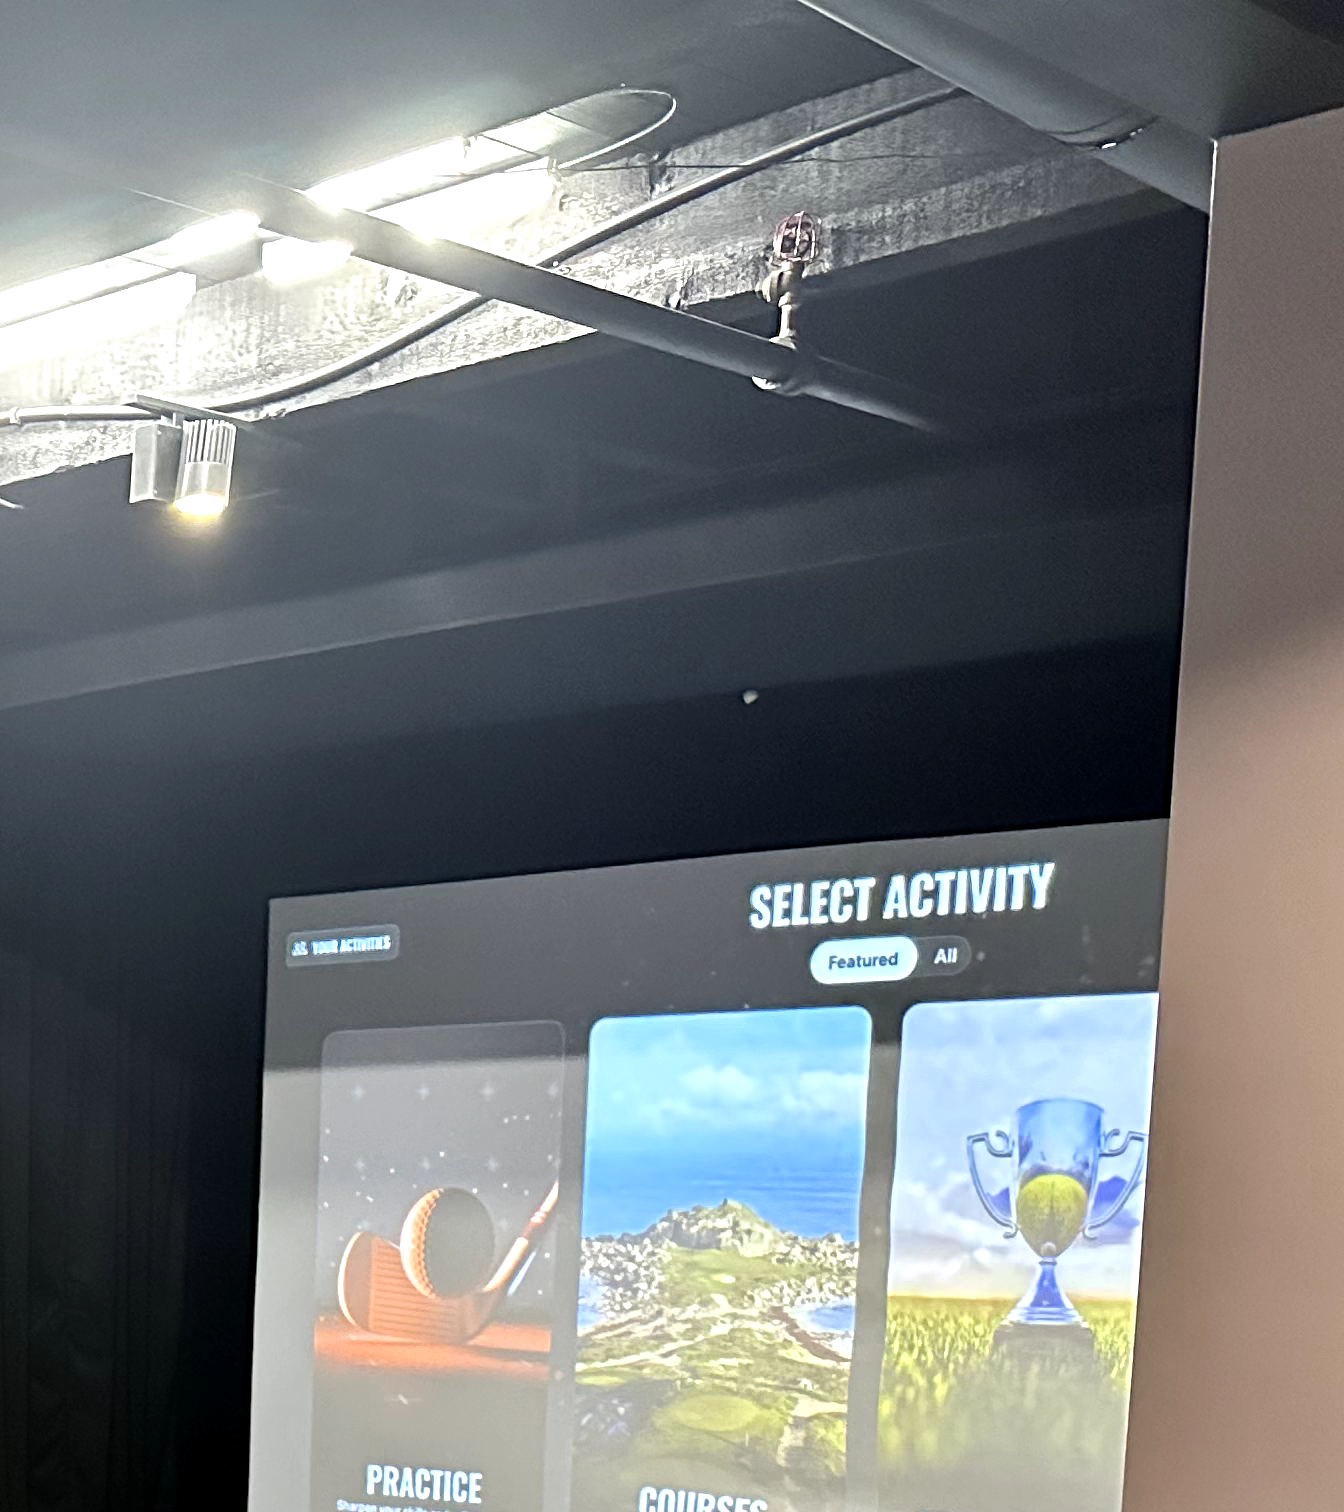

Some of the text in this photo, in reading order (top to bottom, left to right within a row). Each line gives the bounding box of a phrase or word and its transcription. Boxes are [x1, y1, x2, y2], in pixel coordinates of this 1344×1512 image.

[749, 862, 1055, 929] SELECT ACTIVITY
[828, 952, 899, 970] Featured
[933, 947, 957, 965] All
[366, 1463, 483, 1504] PRACTICE
